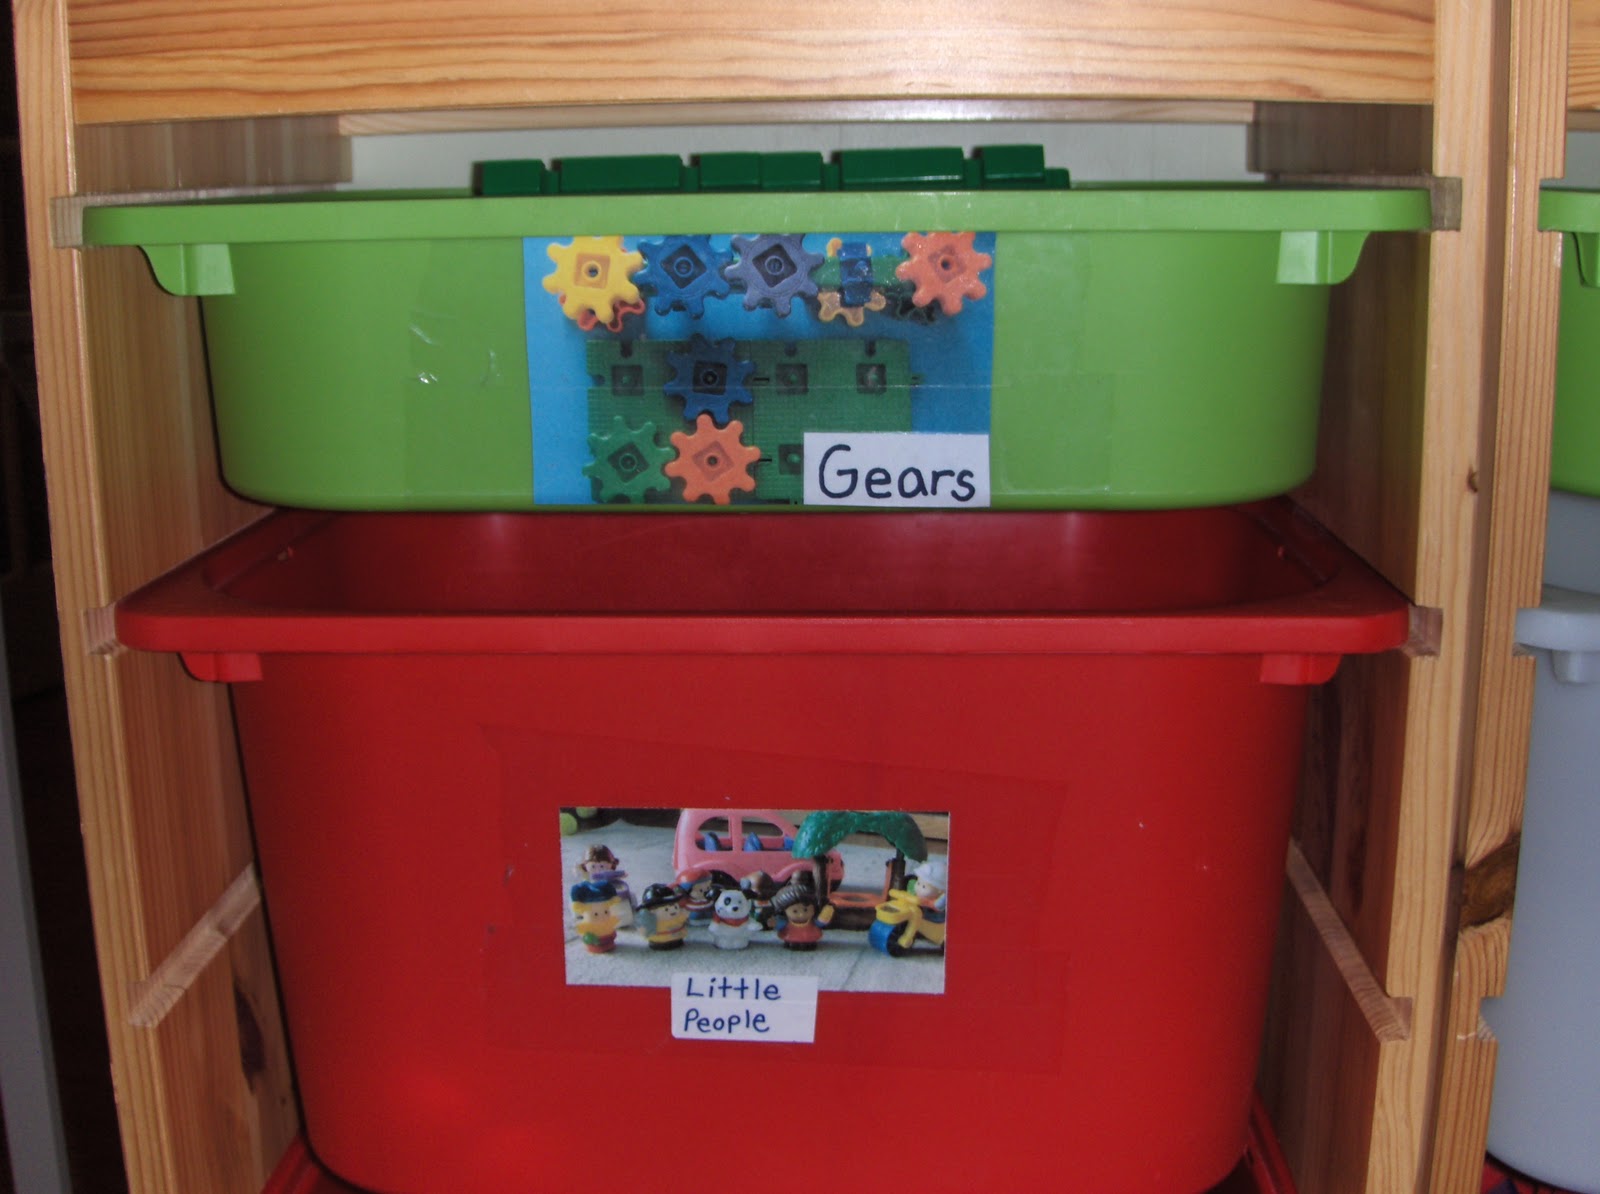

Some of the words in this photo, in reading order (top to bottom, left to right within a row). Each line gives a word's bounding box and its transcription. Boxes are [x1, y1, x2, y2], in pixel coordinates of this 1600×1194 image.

[818, 443, 976, 502] Gears
[686, 976, 781, 1000] Little
[683, 1007, 770, 1033] People
